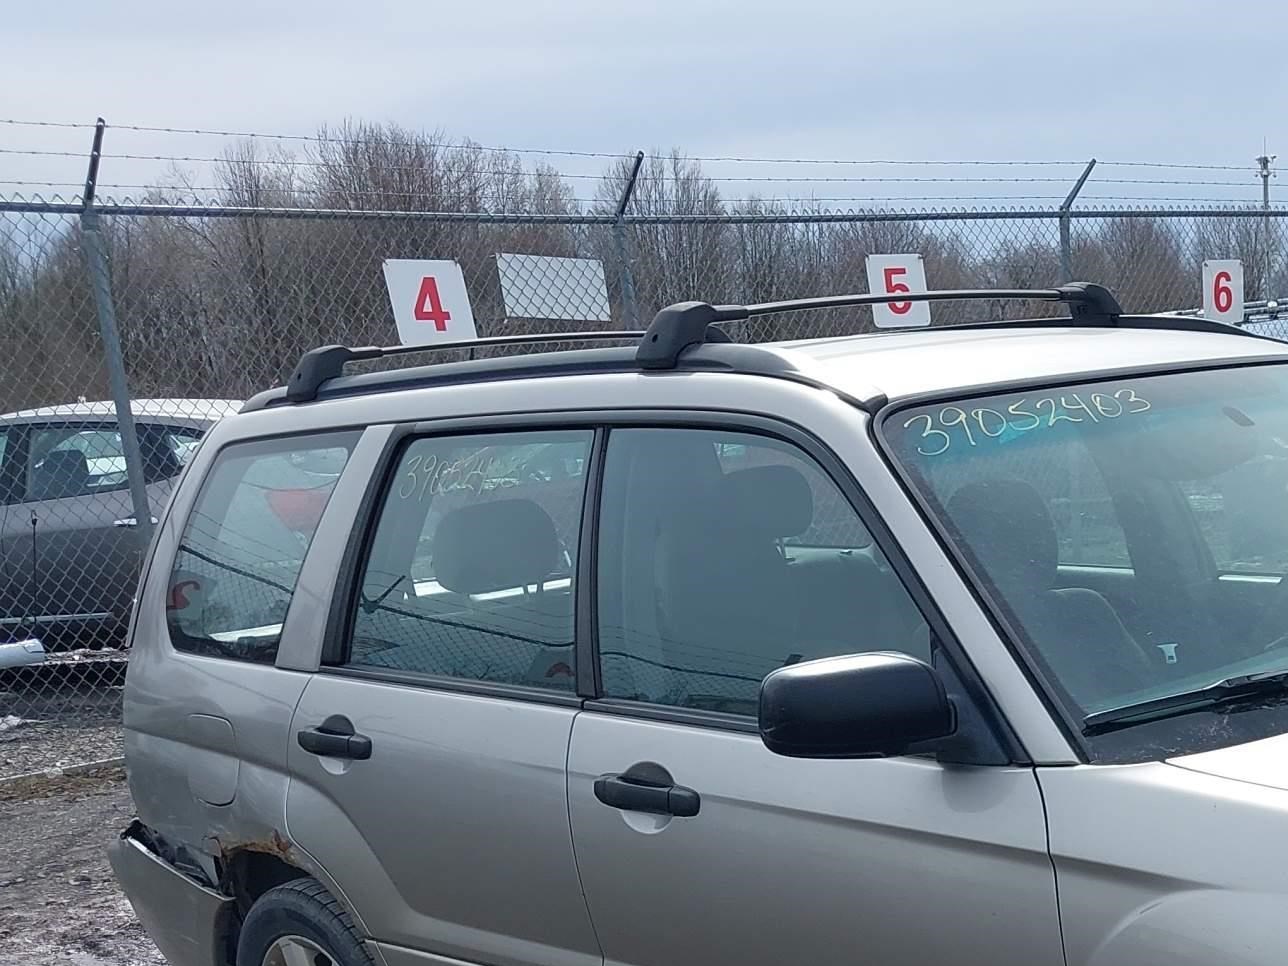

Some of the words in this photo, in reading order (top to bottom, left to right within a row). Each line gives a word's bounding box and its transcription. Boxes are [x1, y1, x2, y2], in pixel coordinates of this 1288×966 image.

[414, 277, 451, 331] 4
[884, 268, 912, 314] 5
[1214, 271, 1232, 312] 6
[903, 389, 1151, 456] 39052403
